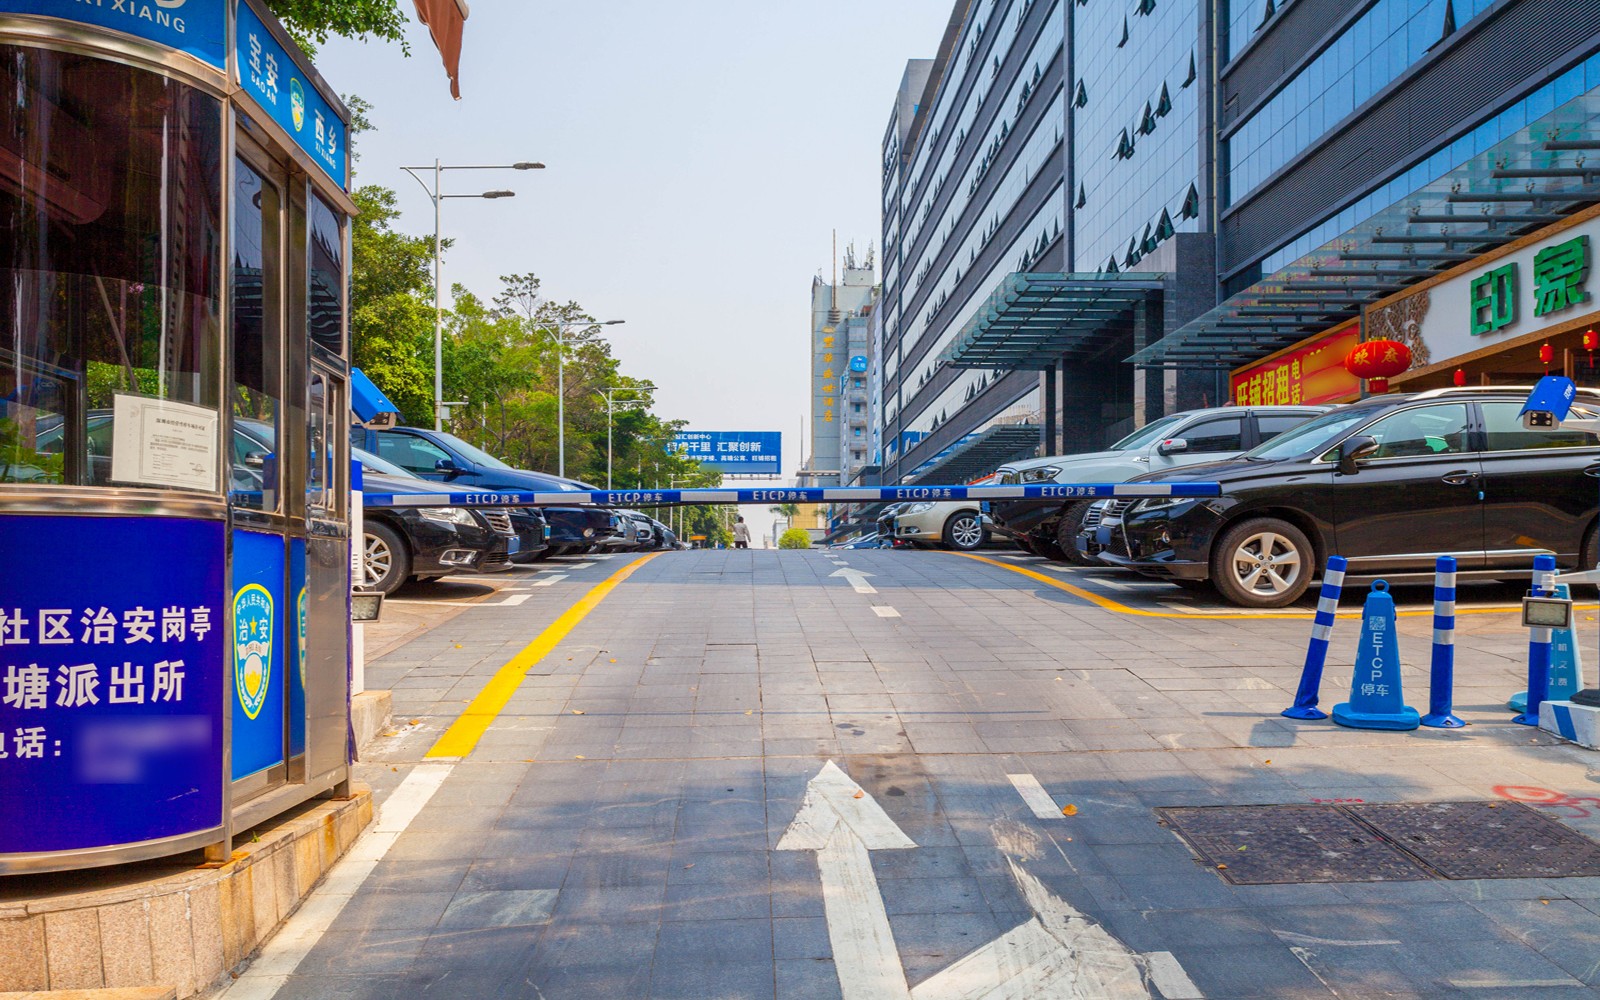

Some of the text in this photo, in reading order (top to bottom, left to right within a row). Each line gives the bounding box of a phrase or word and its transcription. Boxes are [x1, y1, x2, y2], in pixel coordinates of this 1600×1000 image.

[111, 0, 186, 34] XIANG
[249, 33, 337, 155] 宝安 西乡
[251, 71, 266, 93] BAO
[267, 90, 277, 106] AN
[1470, 234, 1590, 336] 印象
[717, 442, 761, 452] 汇聚创新
[465, 494, 520, 504] ETCP 停车
[608, 493, 663, 503] ETCP 停车
[752, 490, 808, 500] ETCP 停车
[896, 488, 951, 499] ETCP 停车
[1041, 486, 1096, 496] ETCP 停车
[0, 605, 212, 645] 社区治安岗亭
[1371, 632, 1384, 682] ETCP
[3, 659, 186, 710] 塘派出所
[1361, 683, 1389, 697] 停车
[0, 726, 62, 759] 话：
